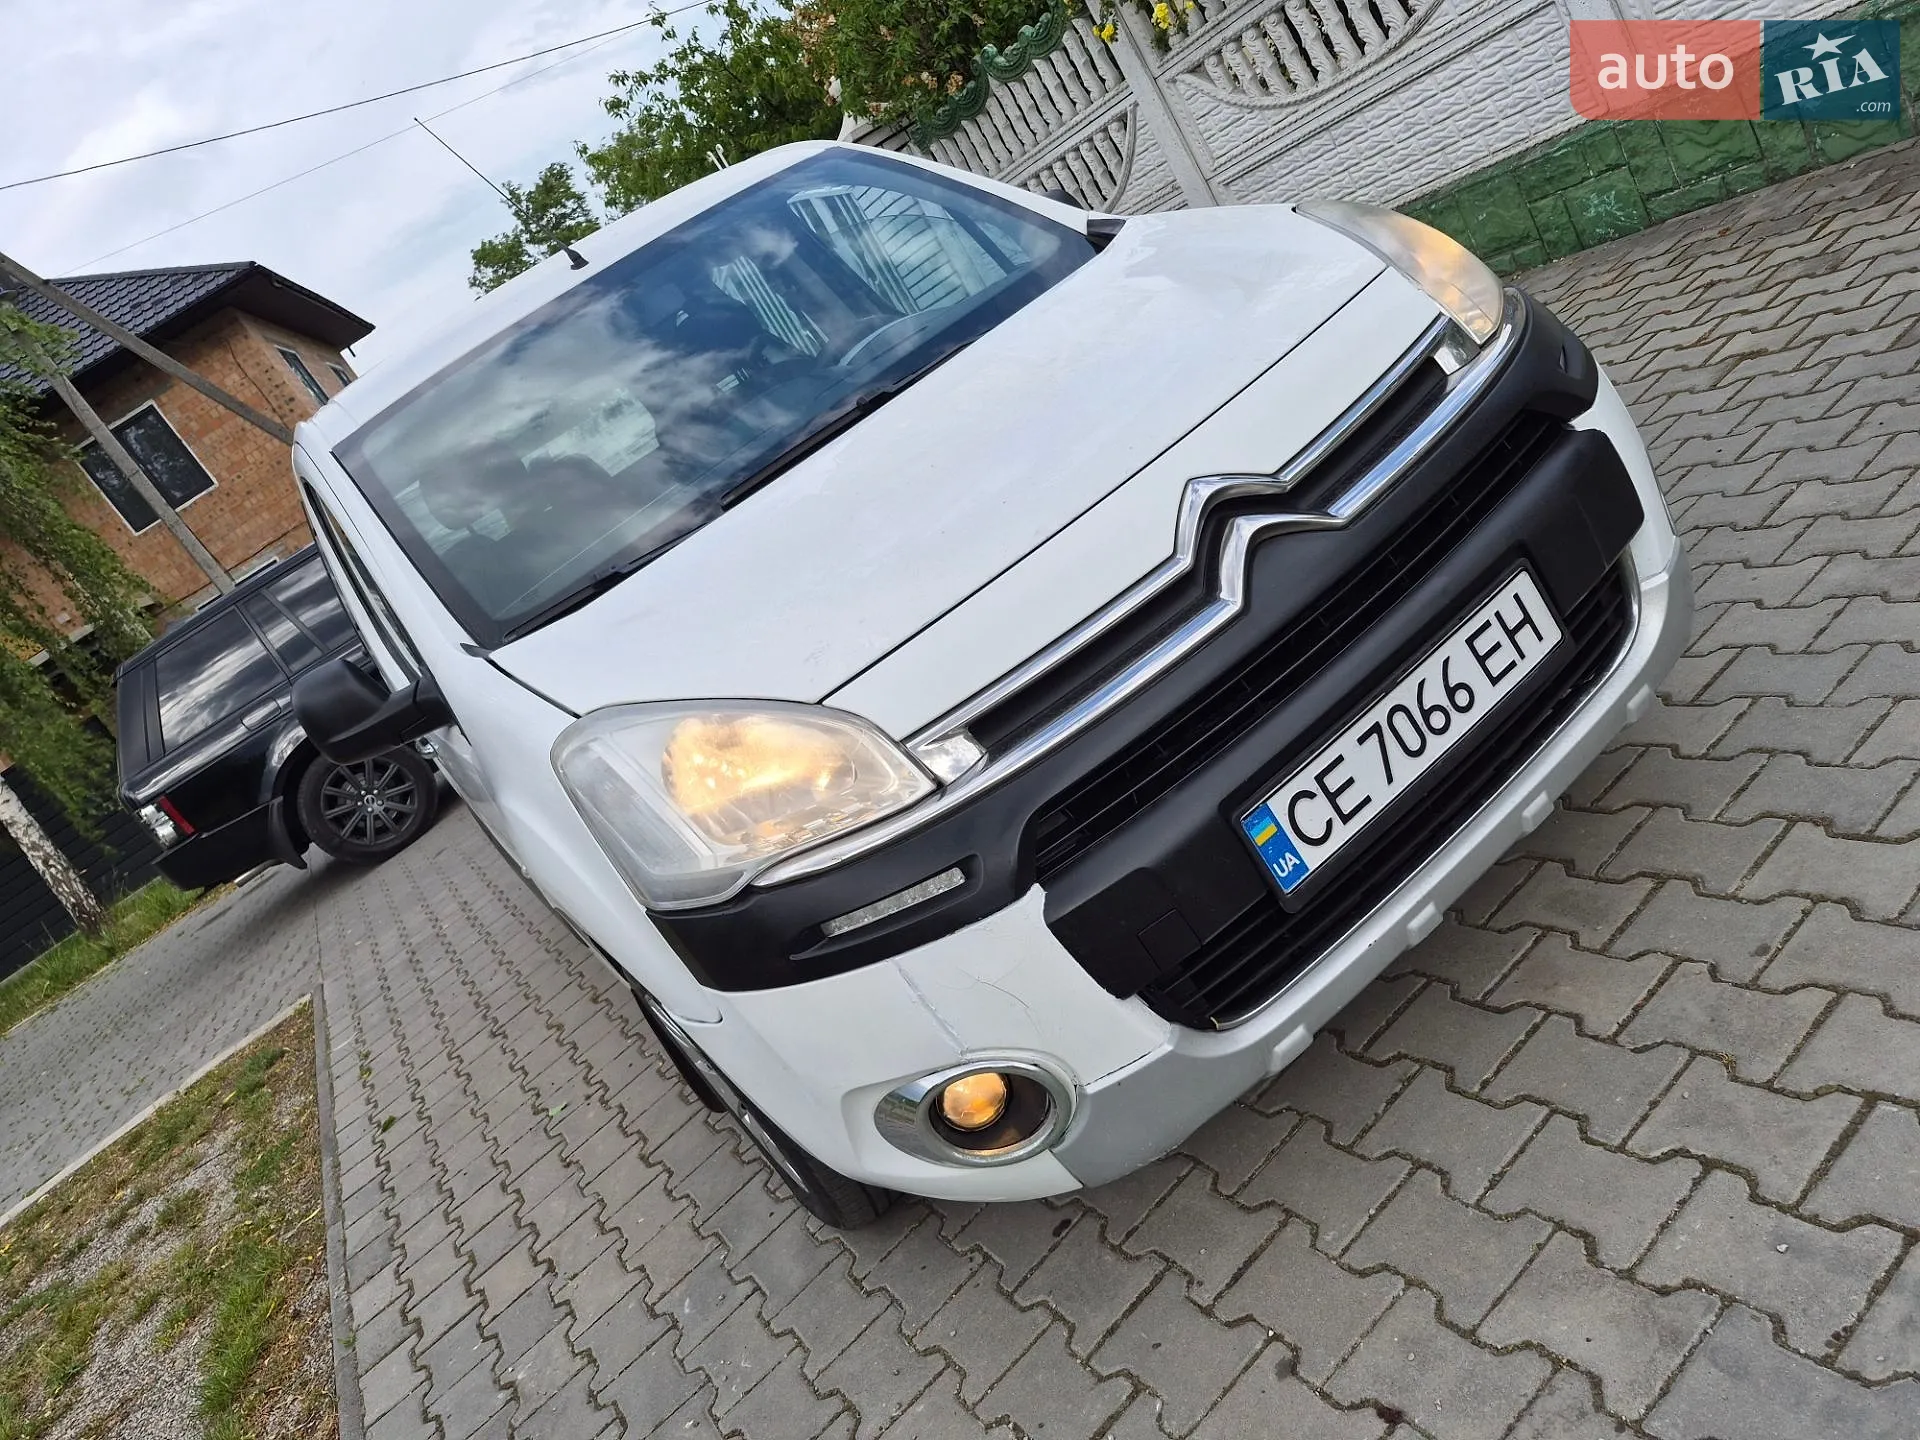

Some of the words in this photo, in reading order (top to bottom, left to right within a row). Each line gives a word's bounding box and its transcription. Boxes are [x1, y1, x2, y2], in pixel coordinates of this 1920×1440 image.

[1287, 754, 1372, 847] CE
[1357, 656, 1475, 785] 7066
[1465, 592, 1544, 687] EH
[1272, 852, 1300, 878] UA
